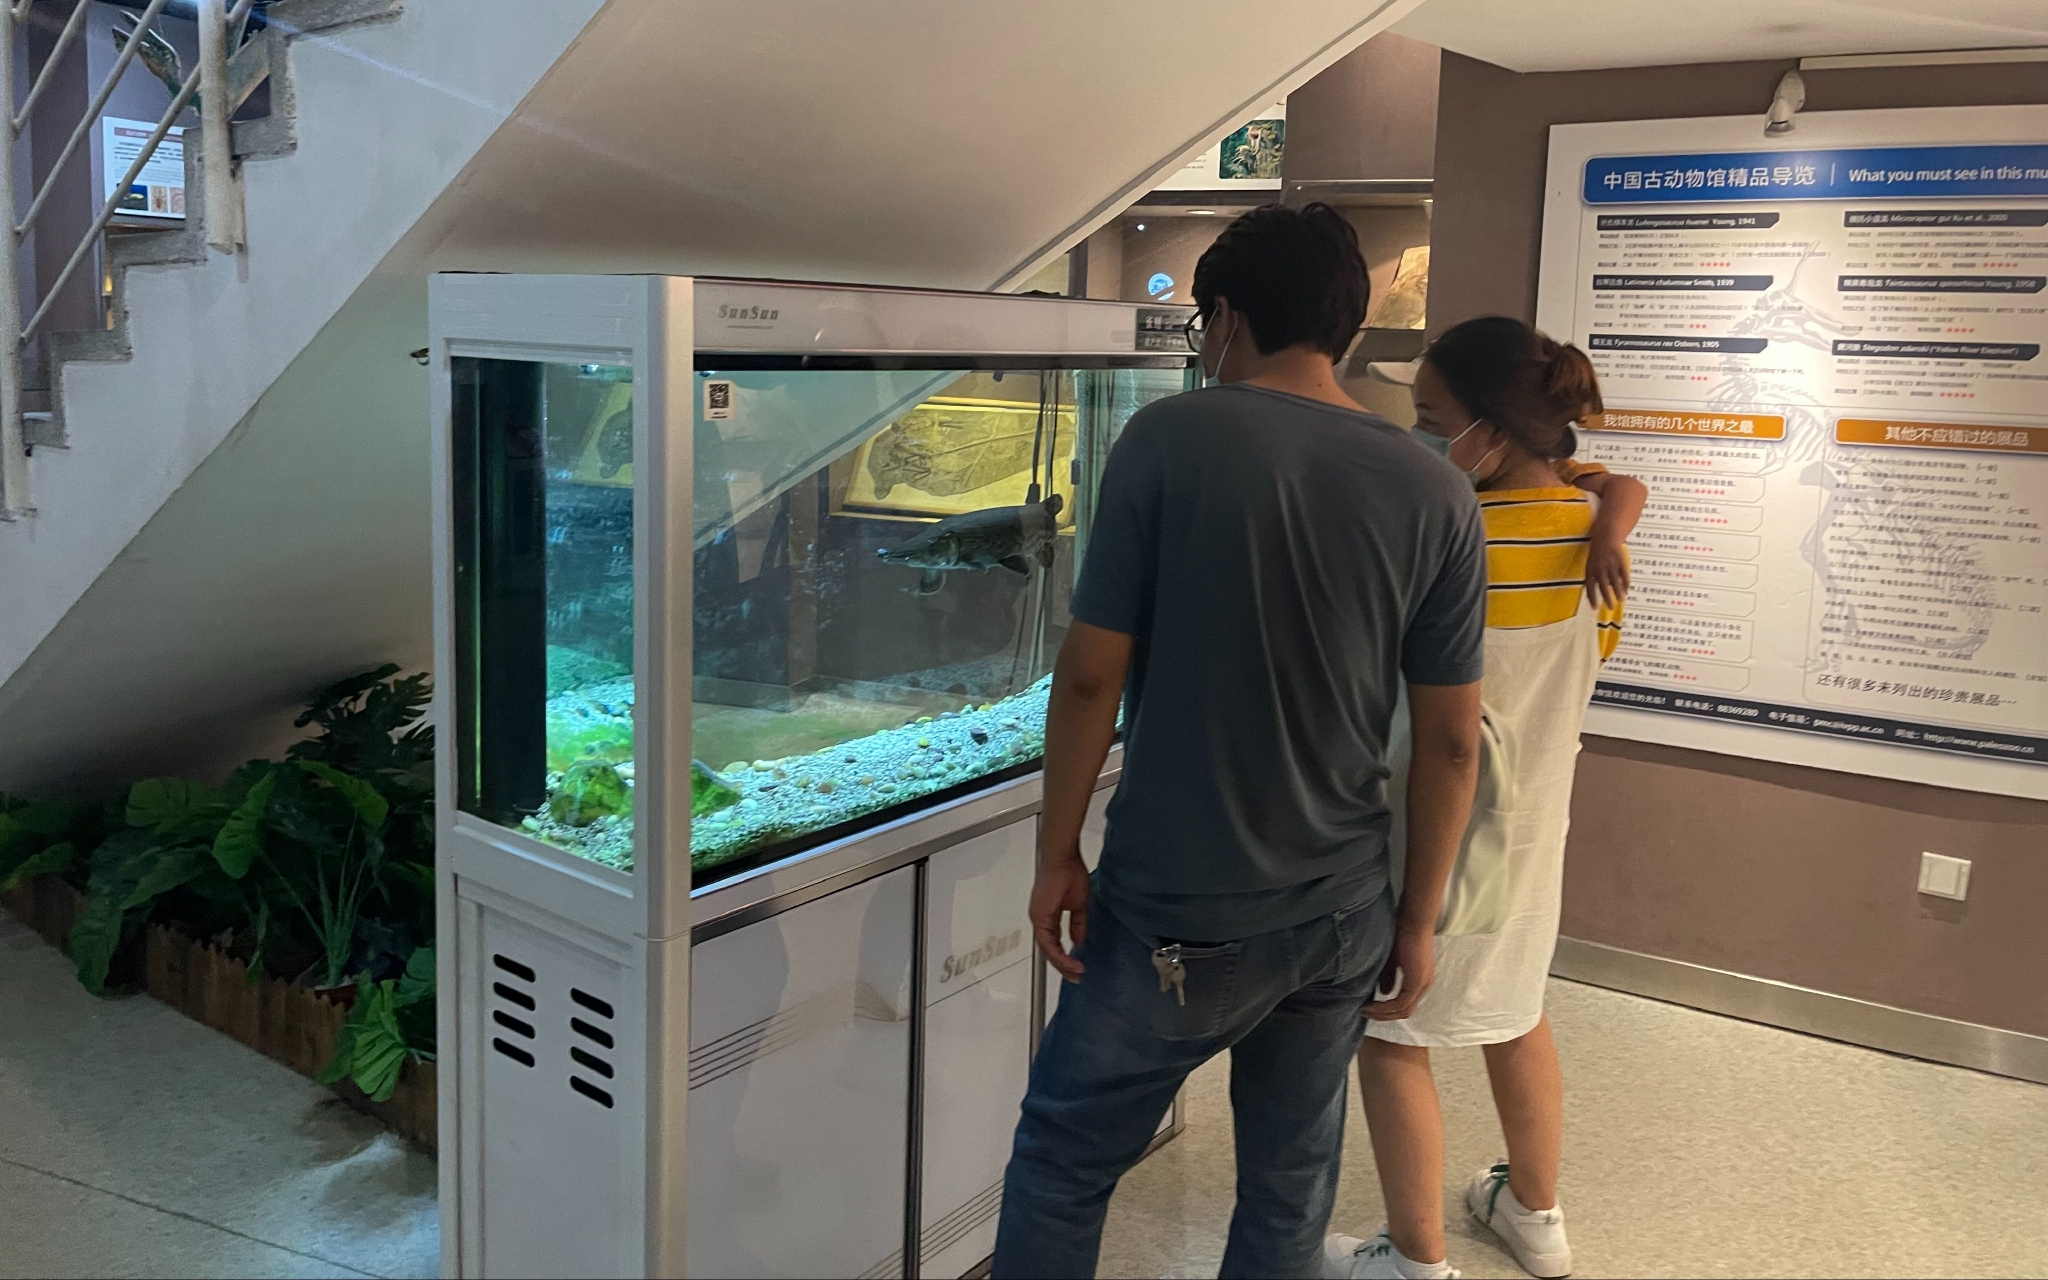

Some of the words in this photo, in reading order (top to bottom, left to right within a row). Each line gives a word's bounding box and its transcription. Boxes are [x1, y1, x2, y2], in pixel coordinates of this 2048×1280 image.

[1603, 165, 1817, 191] 中国古动物馆精品导览
[1849, 168, 1885, 183] What
[1887, 170, 1915, 185] you
[1916, 168, 1952, 182] must
[1954, 169, 1978, 181] see
[1980, 166, 1994, 180] in
[1996, 165, 2023, 180] this
[1738, 217, 1756, 225] 1941
[717, 304, 779, 320] SunSun
[1602, 413, 1755, 435] 我馆拥有的几个世界之最
[1884, 425, 2029, 447] 其他不应错过的展品
